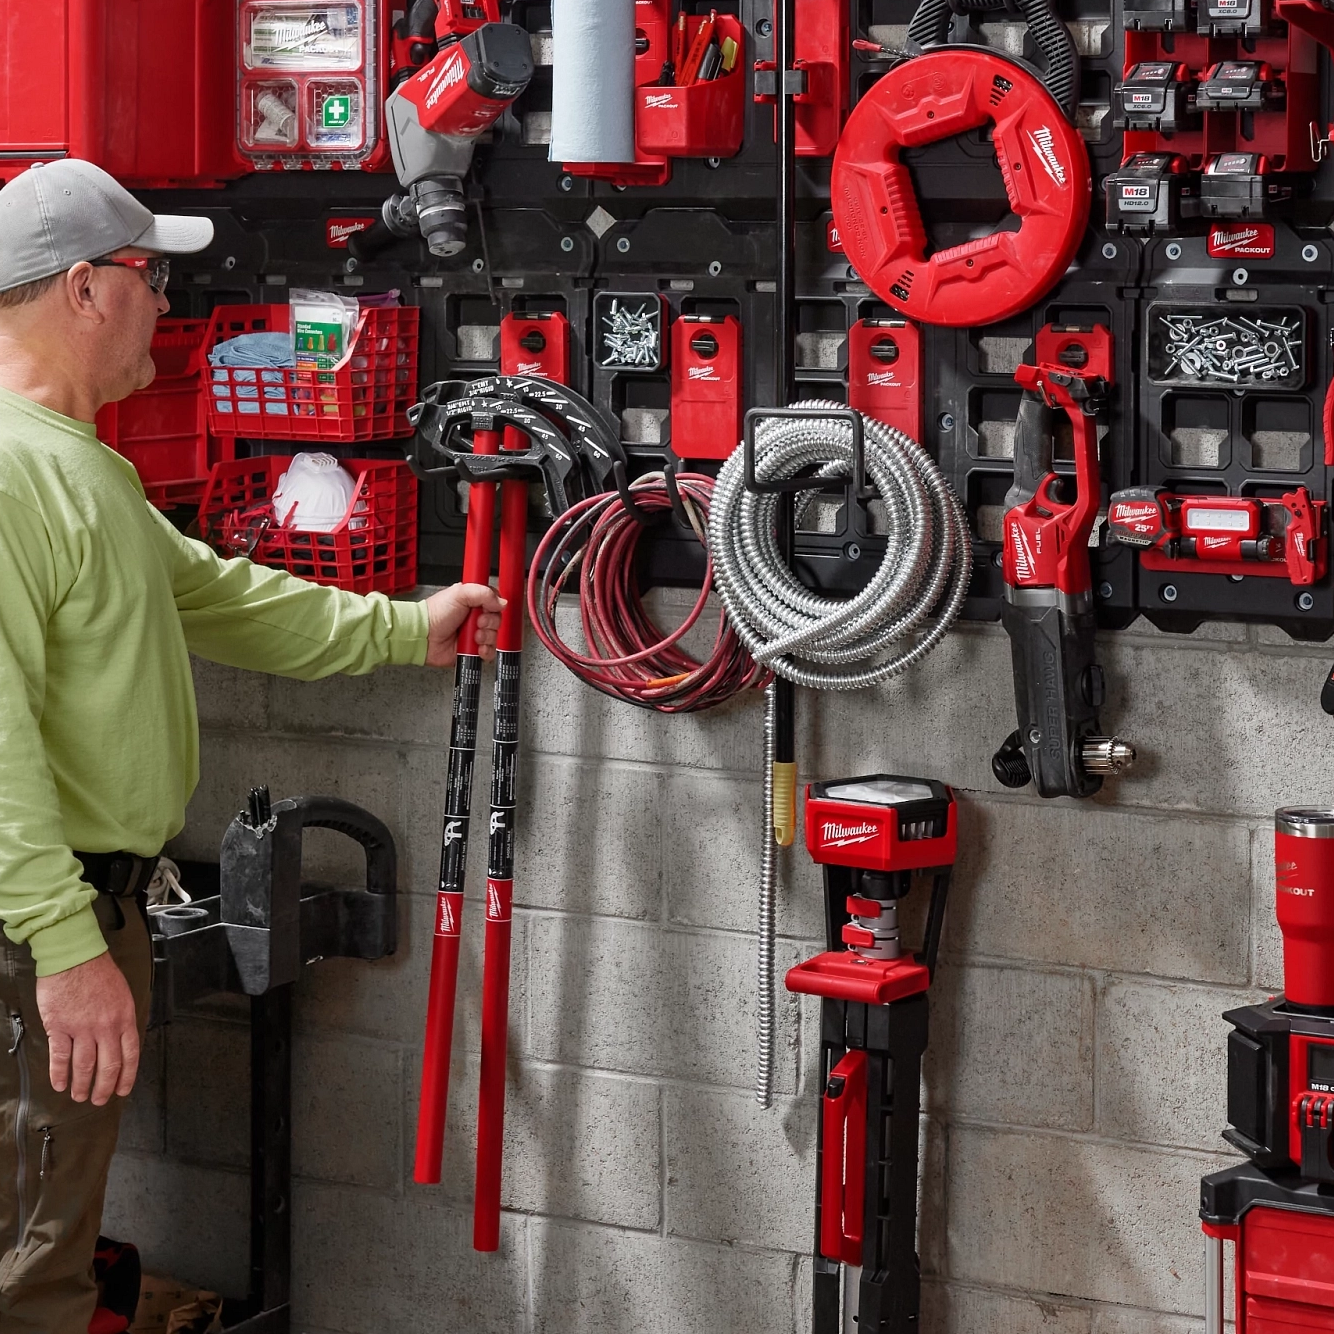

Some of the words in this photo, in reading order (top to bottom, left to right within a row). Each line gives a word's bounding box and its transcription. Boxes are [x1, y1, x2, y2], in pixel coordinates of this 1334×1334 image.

[273, 20, 327, 46] Milwaukee
[417, 66, 436, 82] FUEL
[425, 56, 465, 109] Milwaukee
[644, 93, 672, 107] Milwaukee
[1033, 124, 1066, 184] Milwaukee
[1124, 188, 1148, 196] M18
[329, 222, 365, 239] Milwaukee
[1211, 228, 1258, 249] Milwaukee
[867, 371, 894, 382] Milwaukee
[1115, 504, 1157, 518] Milwaukee
[1015, 522, 1027, 582] Milwaukee
[821, 821, 878, 841] Milwaukee
[489, 883, 498, 917] Milwaukee
[440, 895, 452, 933] Milwaukee
[1311, 1083, 1328, 1091] M18
